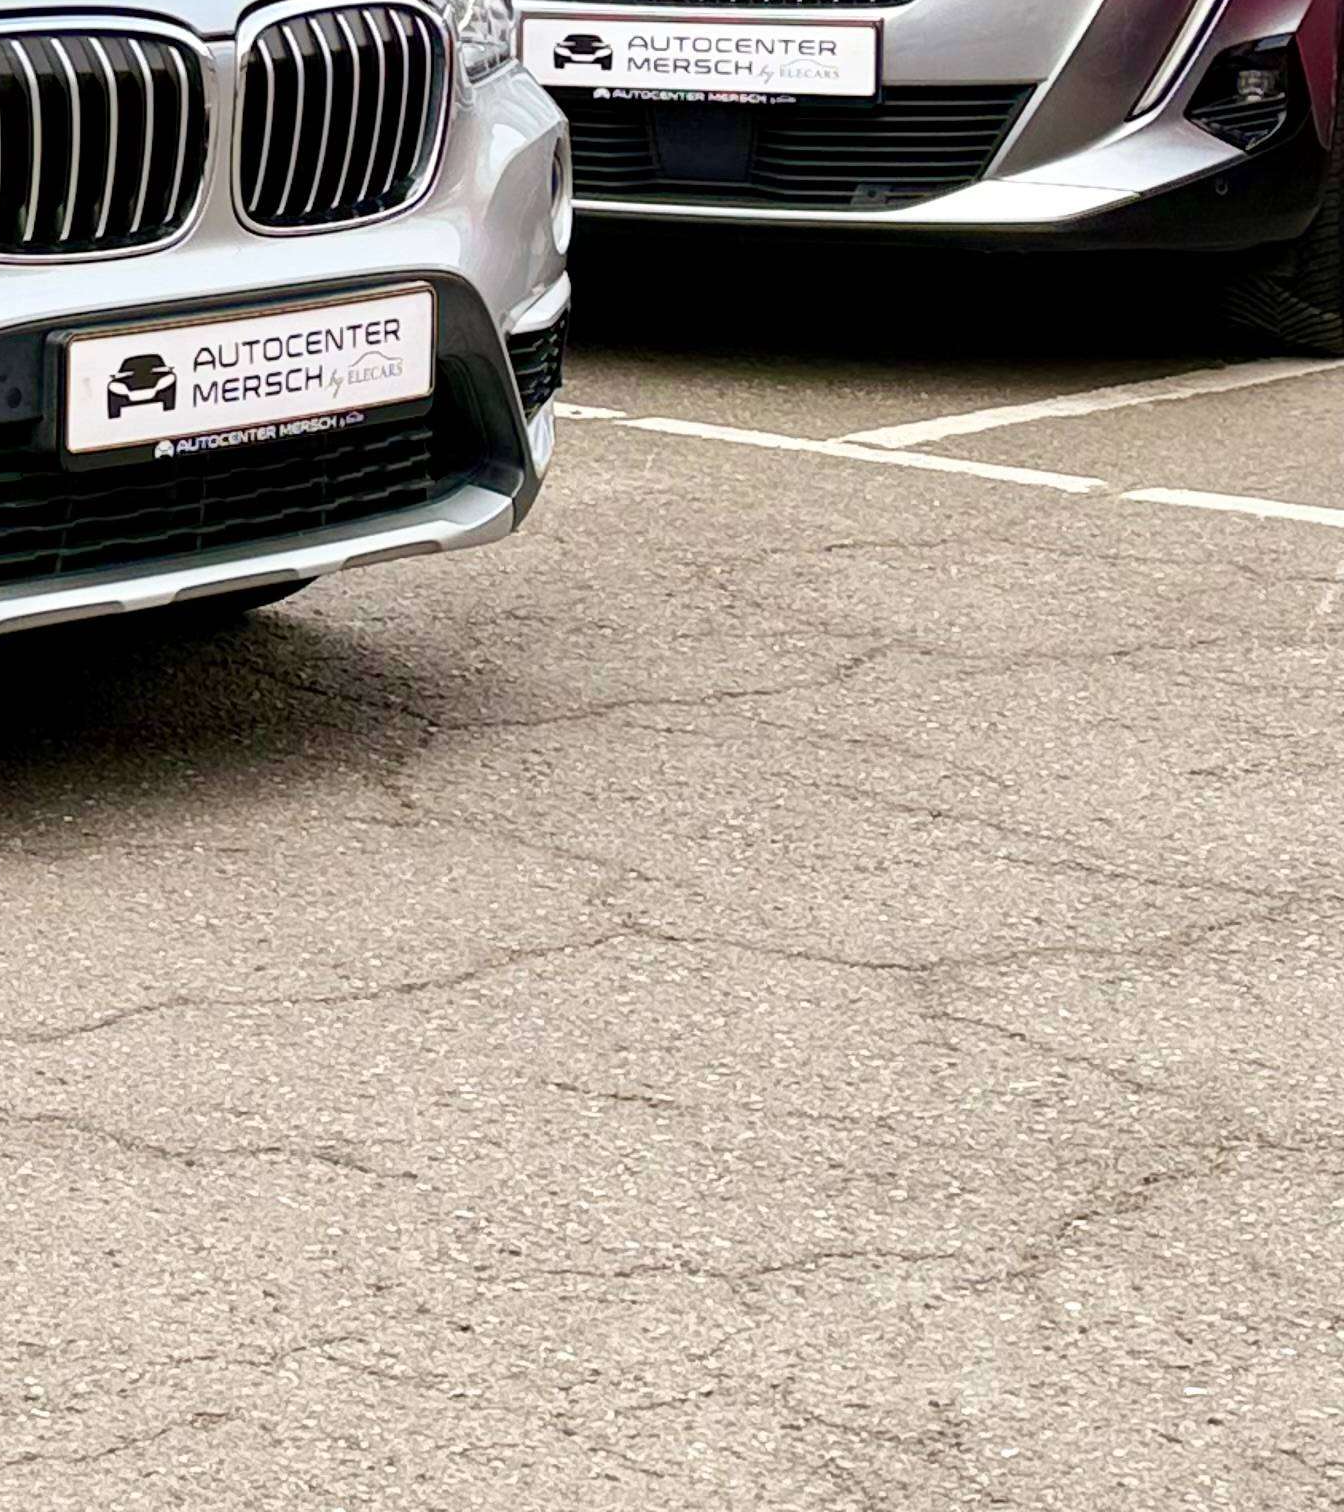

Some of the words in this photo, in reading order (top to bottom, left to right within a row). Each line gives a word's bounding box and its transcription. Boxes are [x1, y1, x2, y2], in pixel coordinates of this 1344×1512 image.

[628, 35, 837, 57] AUTOCENTER
[627, 57, 753, 76] MERSCH
[779, 66, 841, 80] ELECARS
[612, 89, 705, 102] AUTOCENTER
[193, 318, 401, 372] AUTOCENTER
[193, 365, 325, 409] MERSCH
[347, 362, 404, 384] ELECARS
[176, 426, 276, 455] AUTOCENTER
[278, 414, 338, 439] MERSCH
